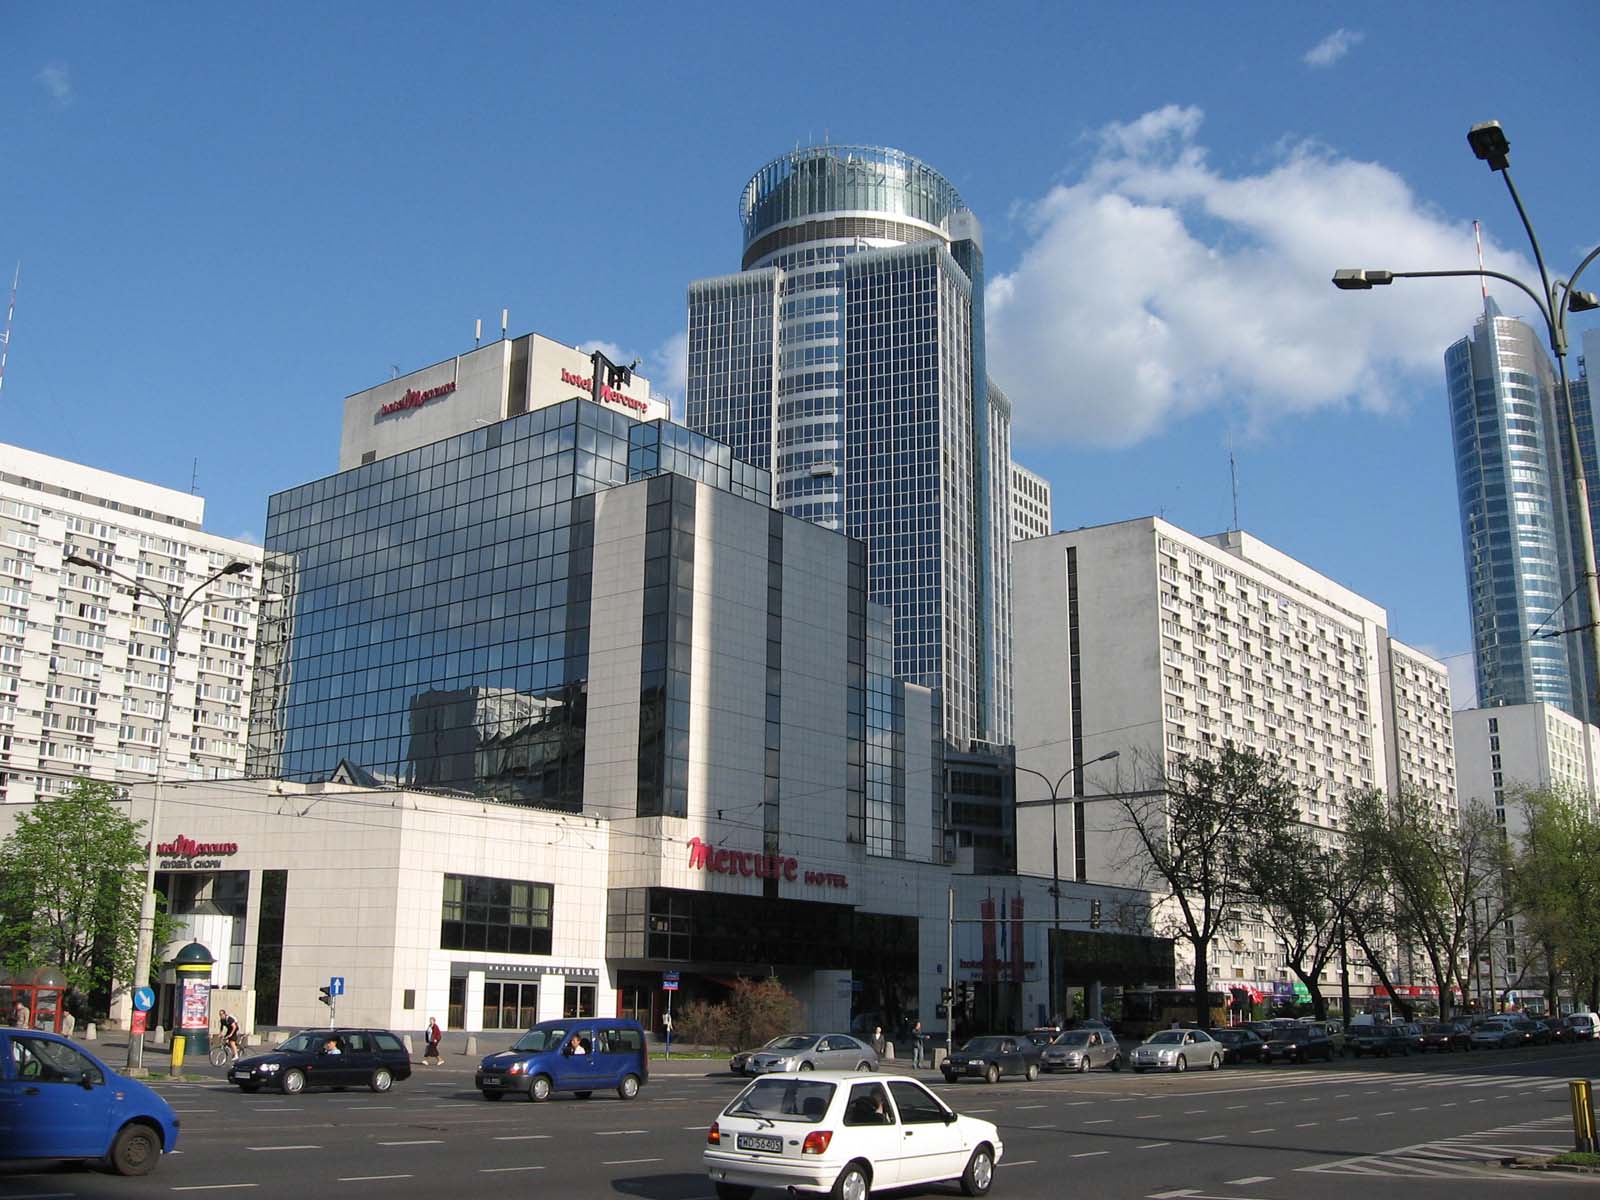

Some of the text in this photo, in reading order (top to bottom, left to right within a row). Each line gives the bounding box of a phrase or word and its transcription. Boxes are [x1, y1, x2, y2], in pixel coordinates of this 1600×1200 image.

[382, 382, 456, 416] hotel Mercure
[561, 367, 648, 413] hotel Mercure
[175, 834, 238, 857] Mercure
[194, 860, 222, 869] CHOPIN
[687, 836, 848, 888] Mercure HOTEL
[546, 967, 599, 977] STANISLAS
